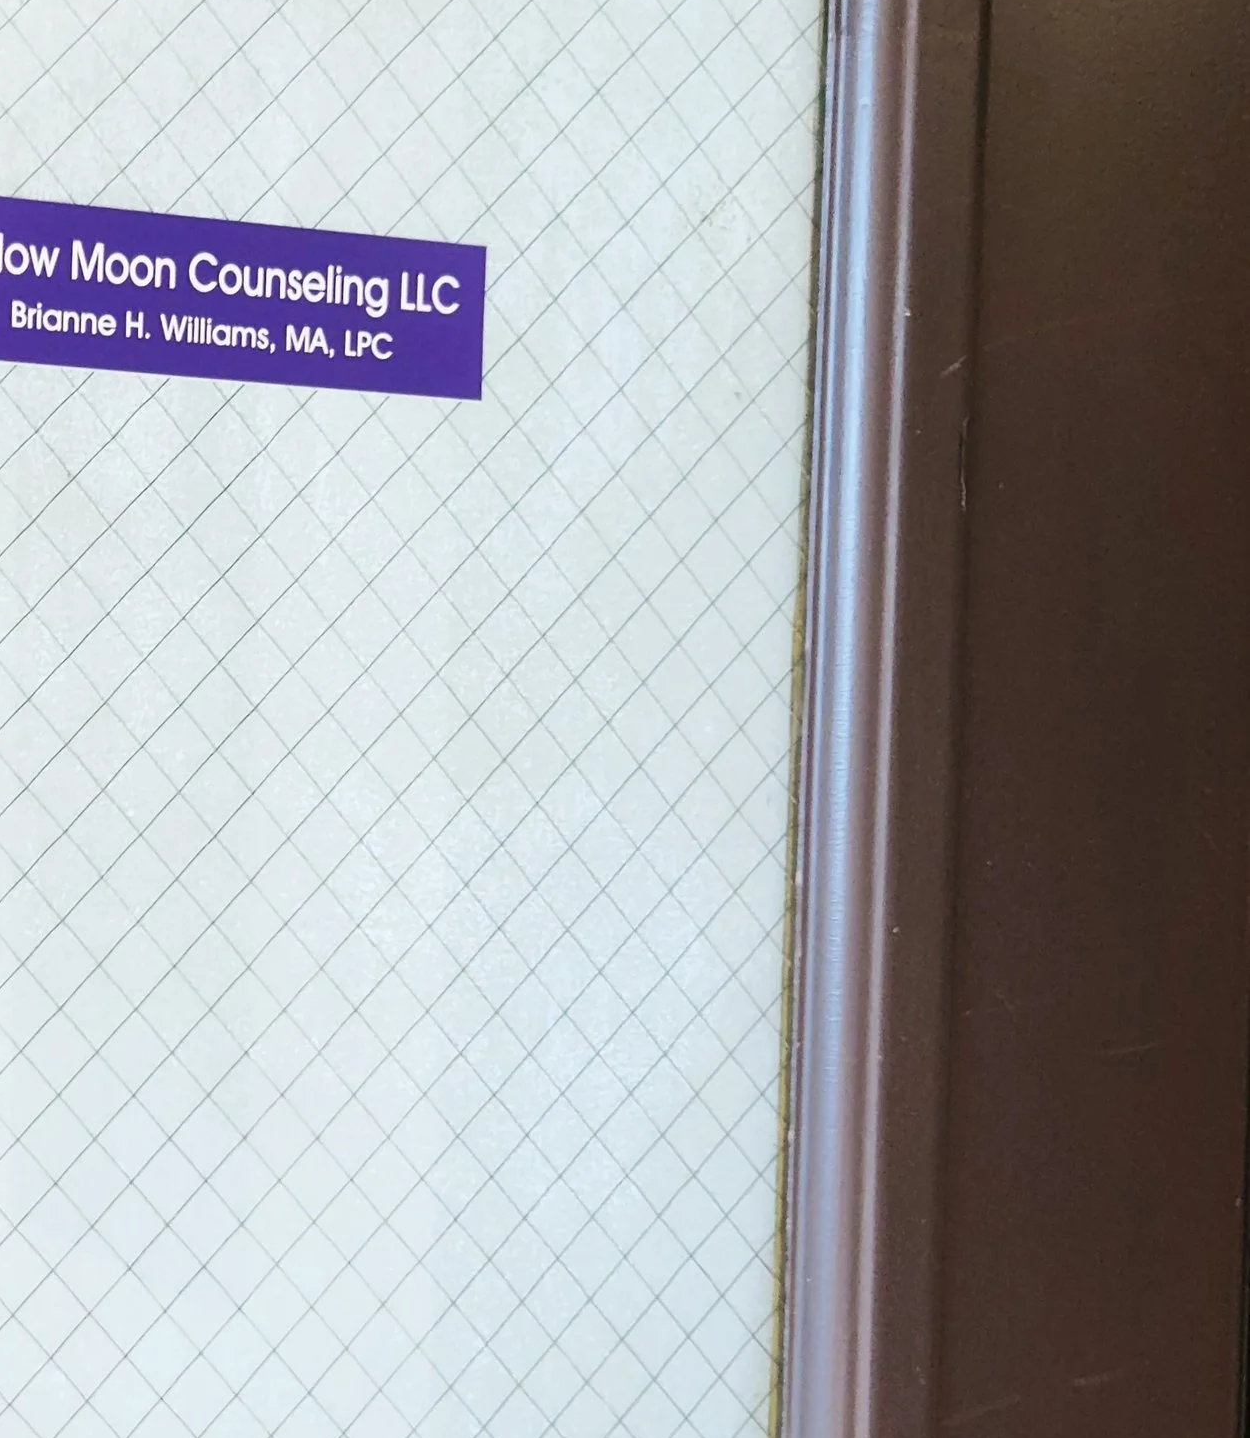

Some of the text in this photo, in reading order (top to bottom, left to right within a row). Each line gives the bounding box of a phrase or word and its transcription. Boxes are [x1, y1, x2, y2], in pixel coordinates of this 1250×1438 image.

[71, 239, 177, 290] Moon
[188, 251, 390, 319] Counseling
[400, 271, 461, 315] LLC
[11, 299, 394, 360] Brianne H. Williams, MA, LPC
